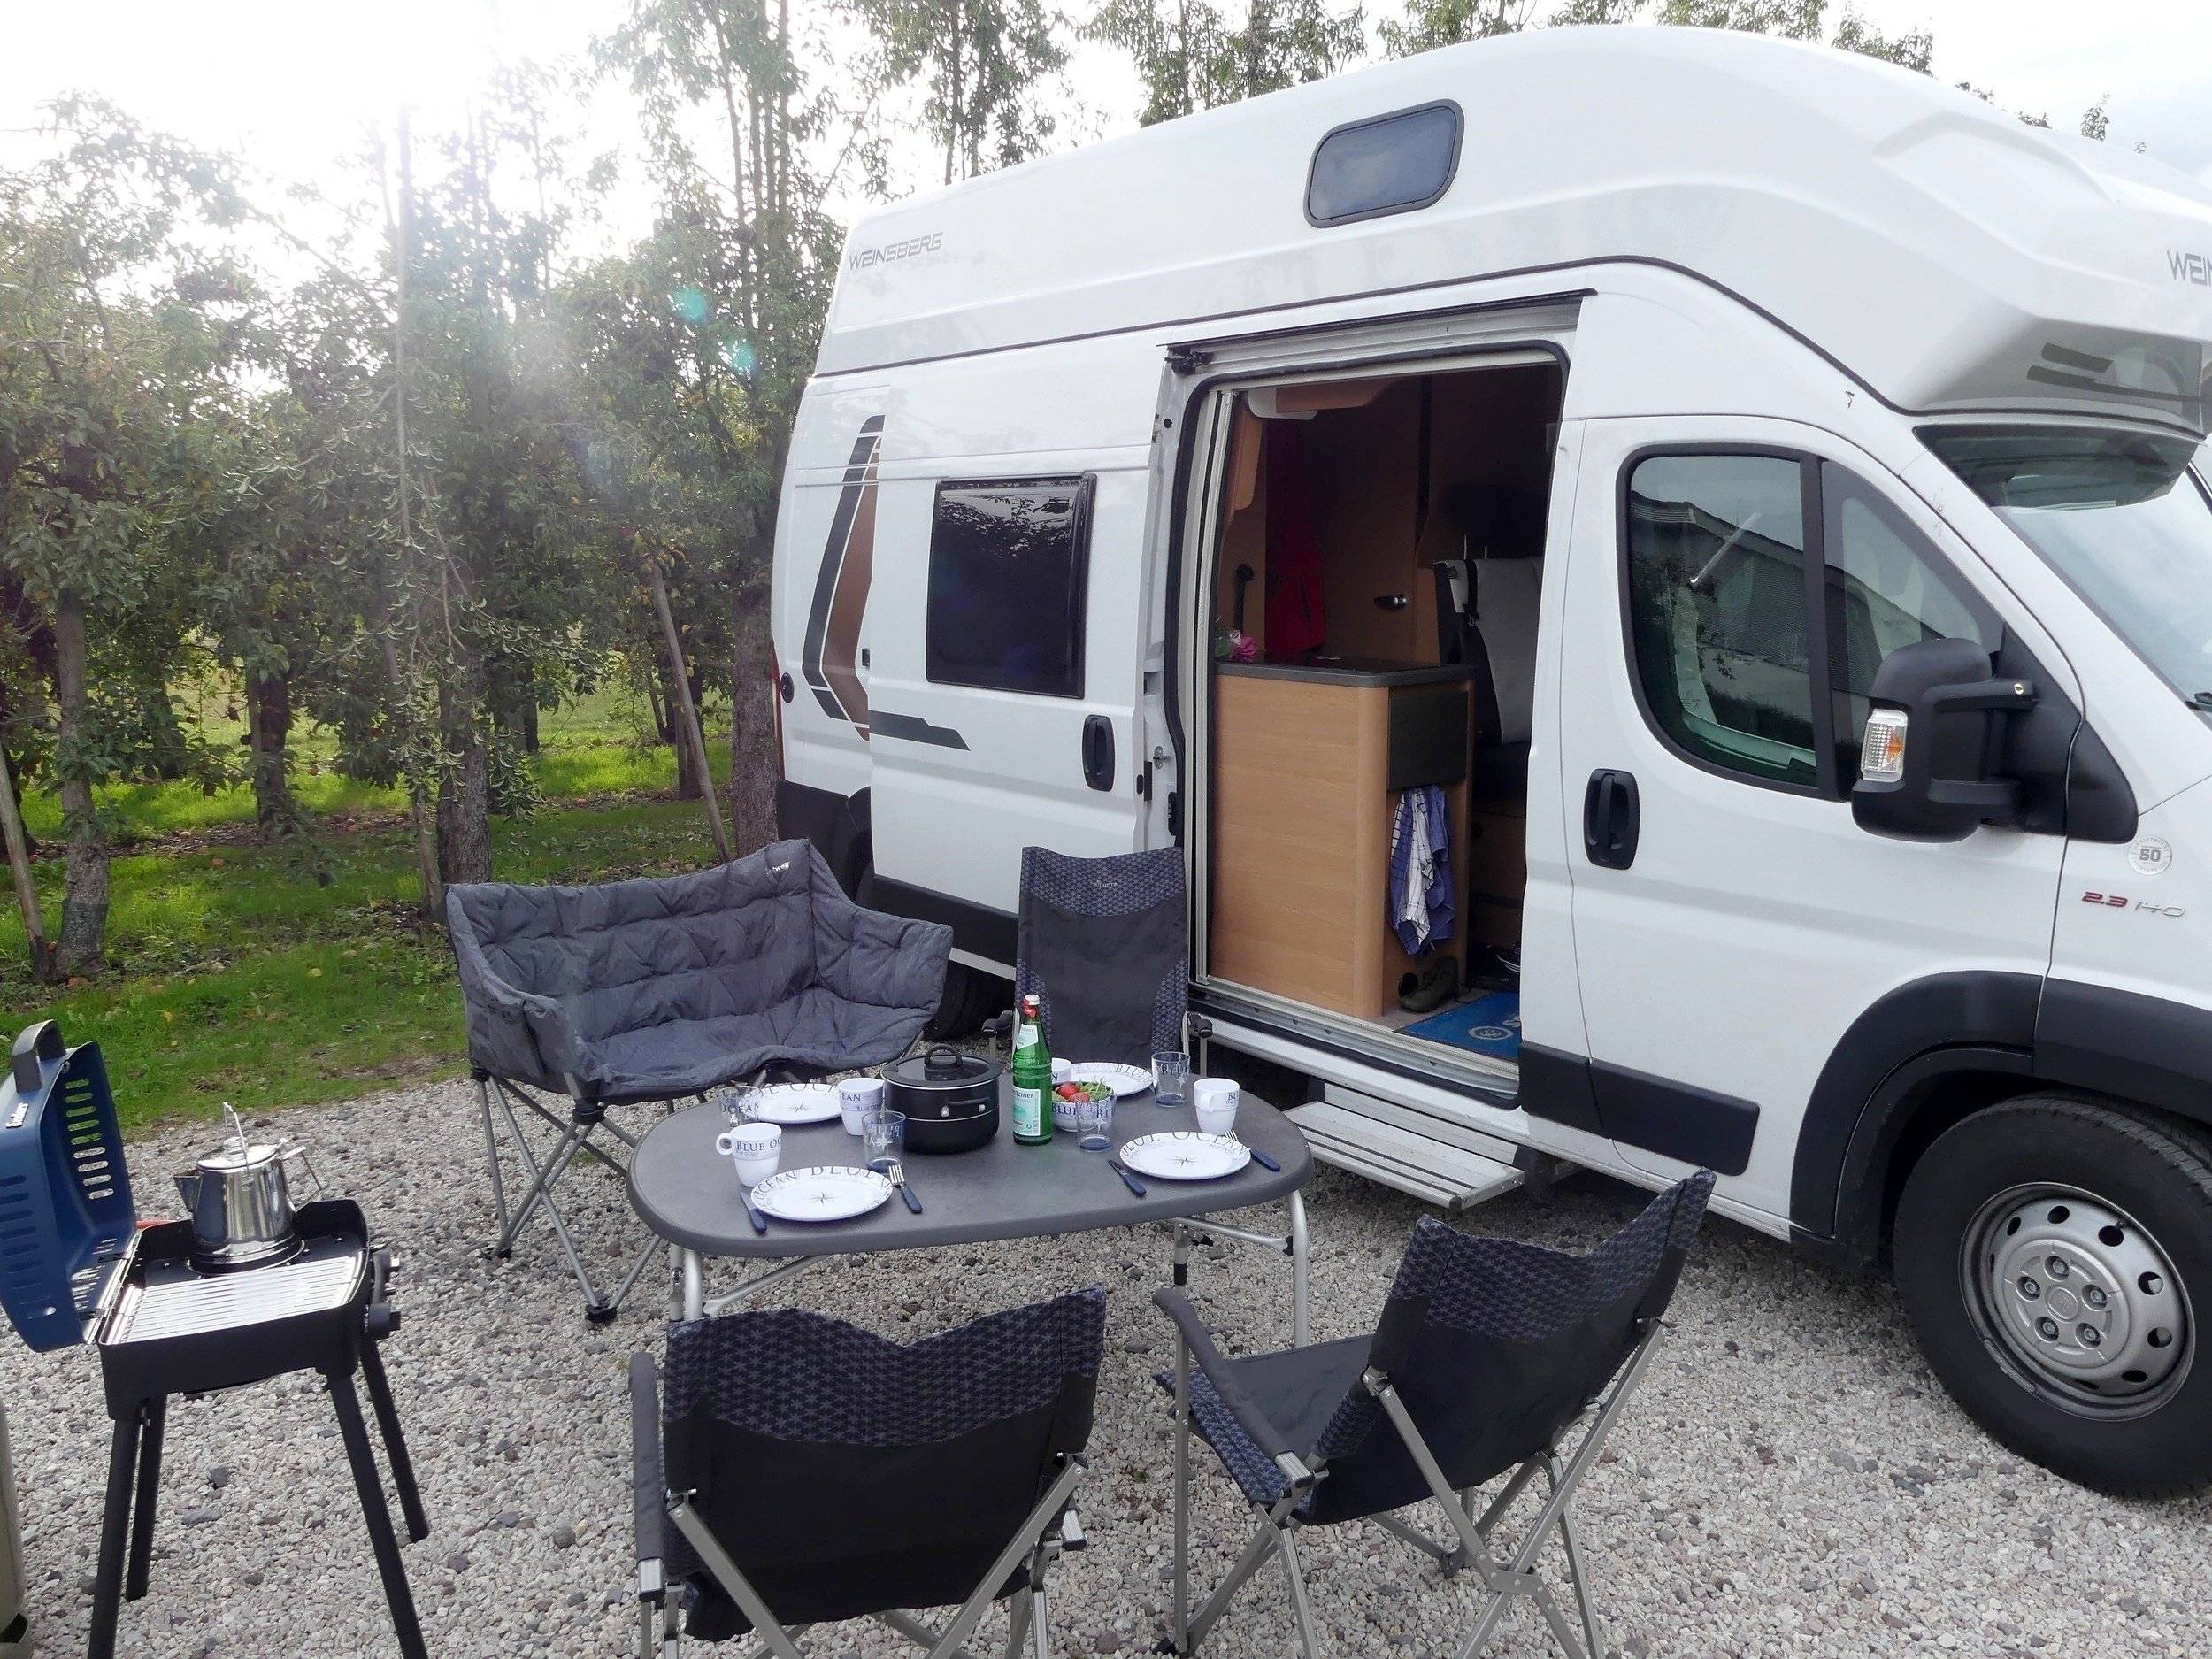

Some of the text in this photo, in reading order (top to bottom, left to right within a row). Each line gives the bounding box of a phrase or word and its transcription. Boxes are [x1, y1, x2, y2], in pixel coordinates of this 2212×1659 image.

[849, 232, 943, 270] WEINSBERG
[2139, 848, 2162, 862] 50
[736, 1141, 766, 1152] BLUE
